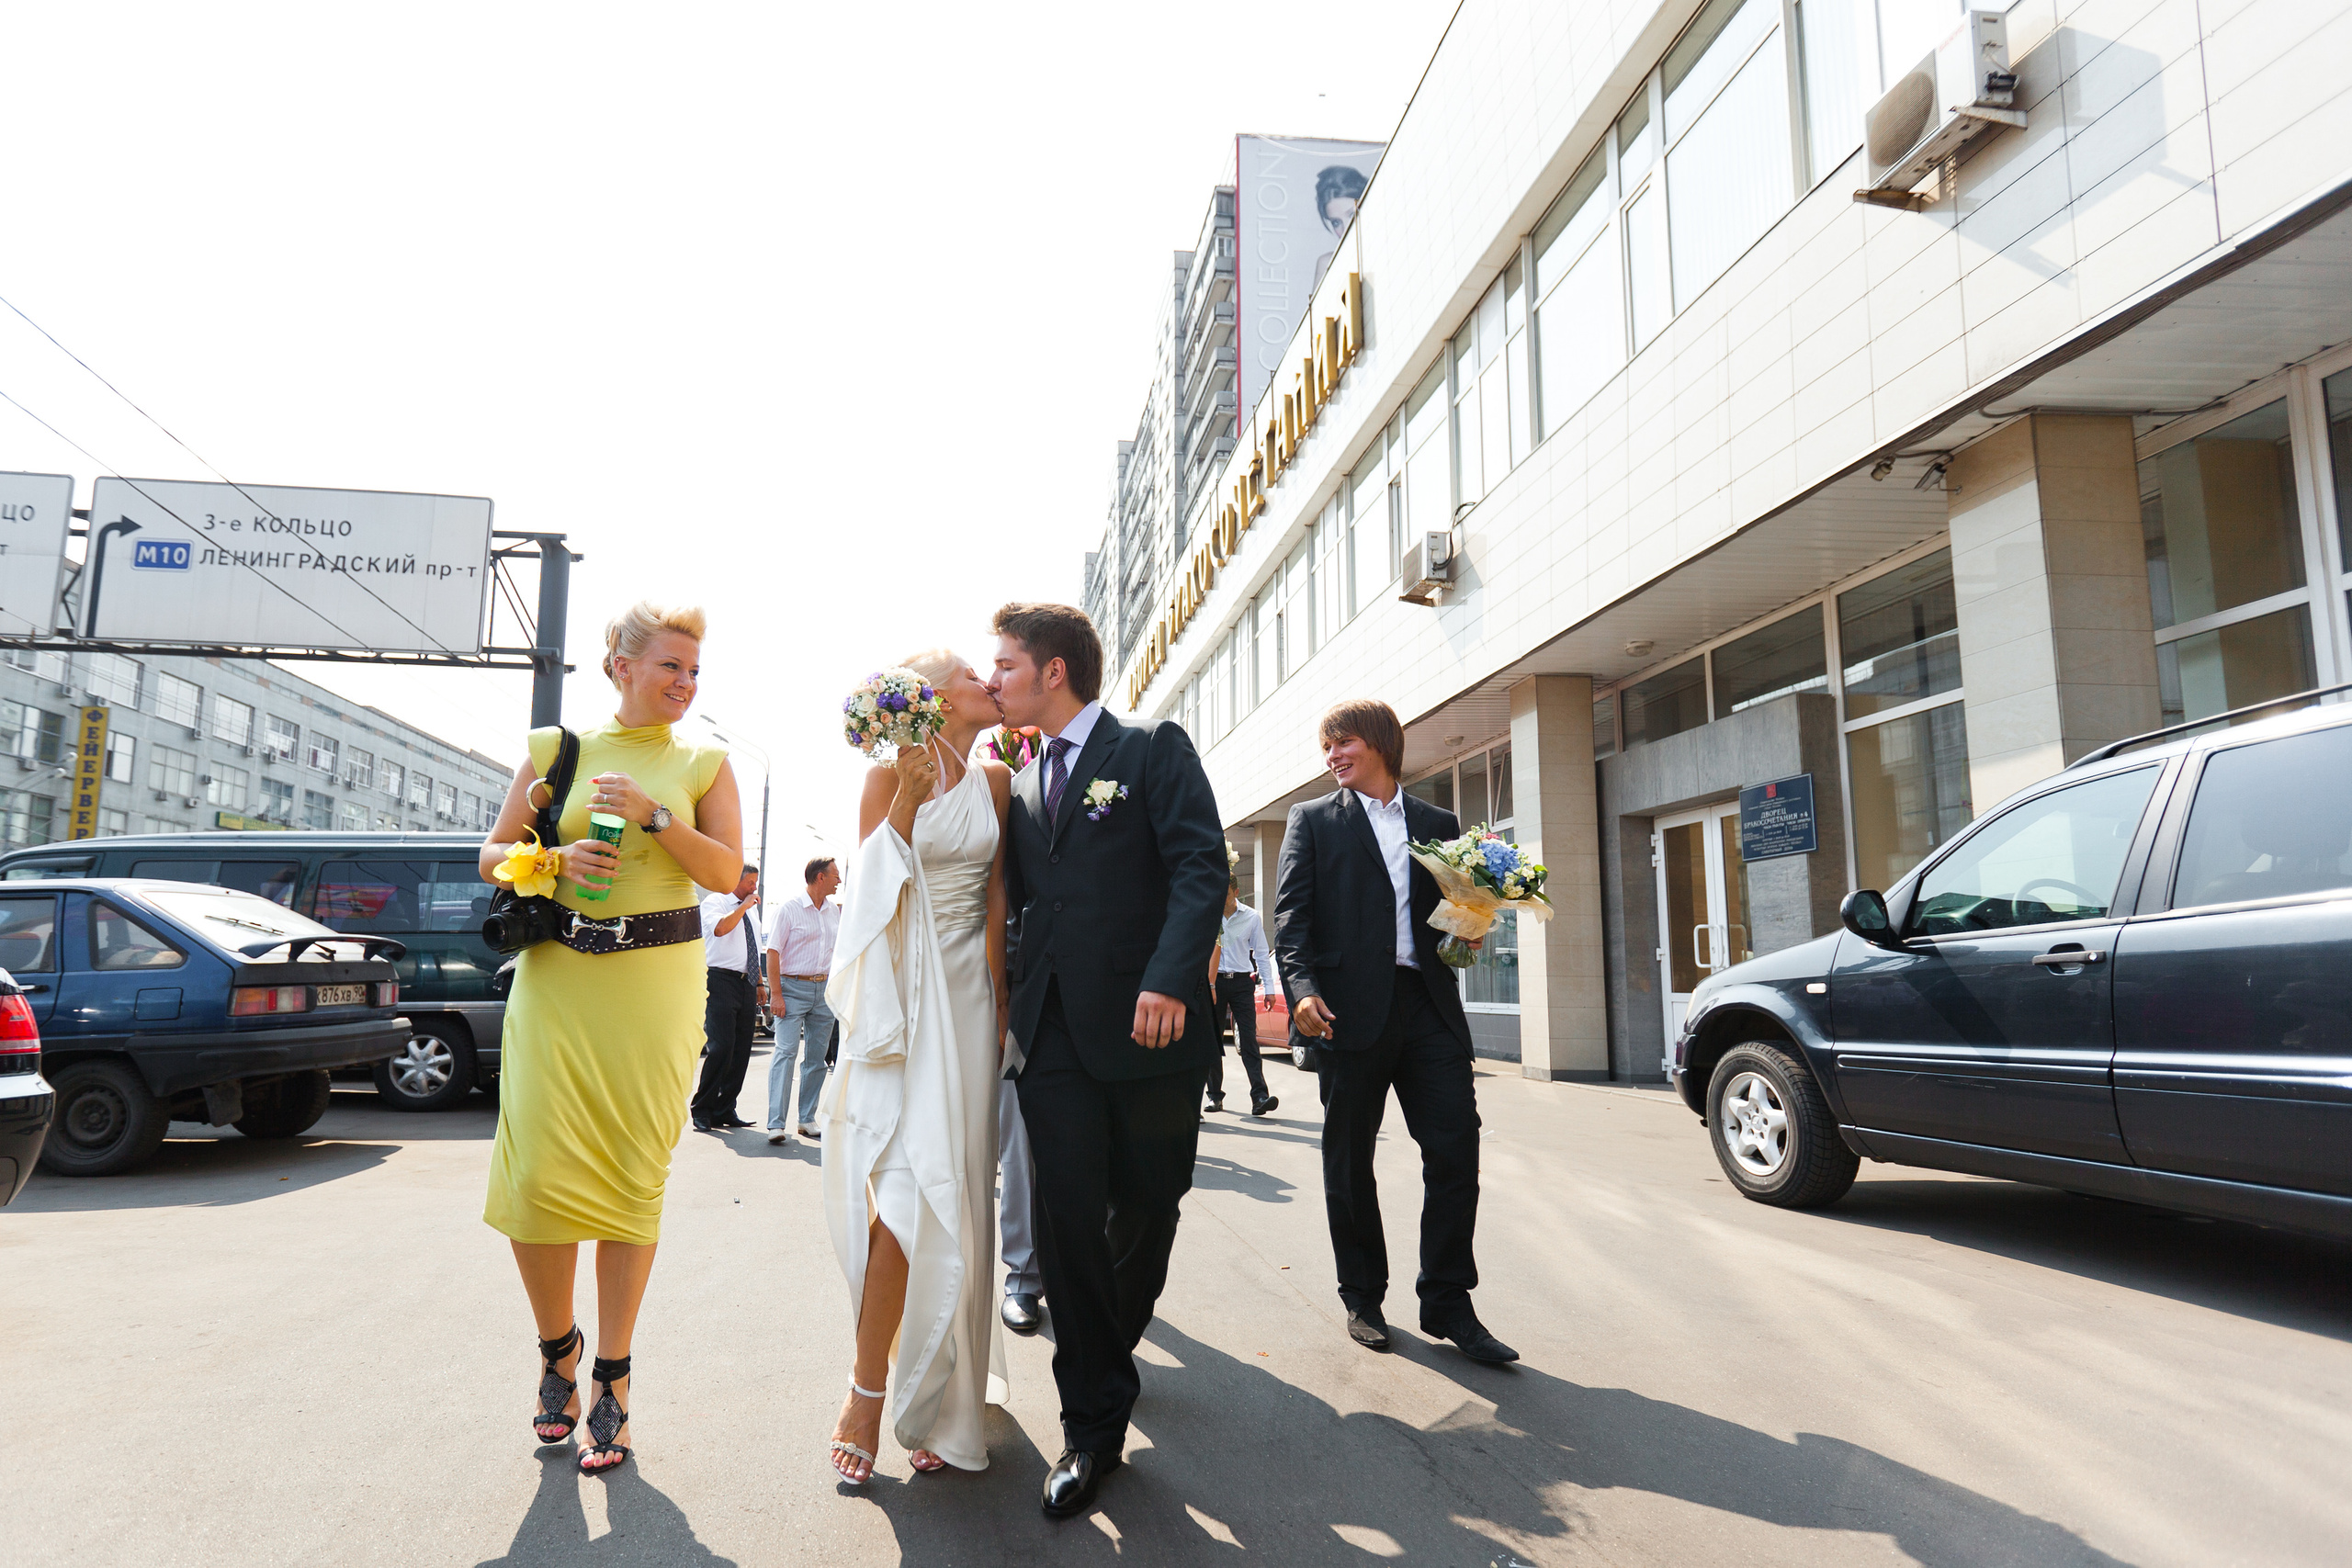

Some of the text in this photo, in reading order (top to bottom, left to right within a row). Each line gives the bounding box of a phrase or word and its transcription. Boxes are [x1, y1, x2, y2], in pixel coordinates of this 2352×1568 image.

[202, 513, 353, 538] 3-е КОЛЬЦО
[137, 546, 187, 565] М10
[198, 548, 478, 580] ЛЕНИНГРАДСКИЙ пр-т
[1744, 812, 1798, 829] БРАКОСОЧЕТАНИЯ
[1761, 807, 1787, 818] ДВОРЕЦ
